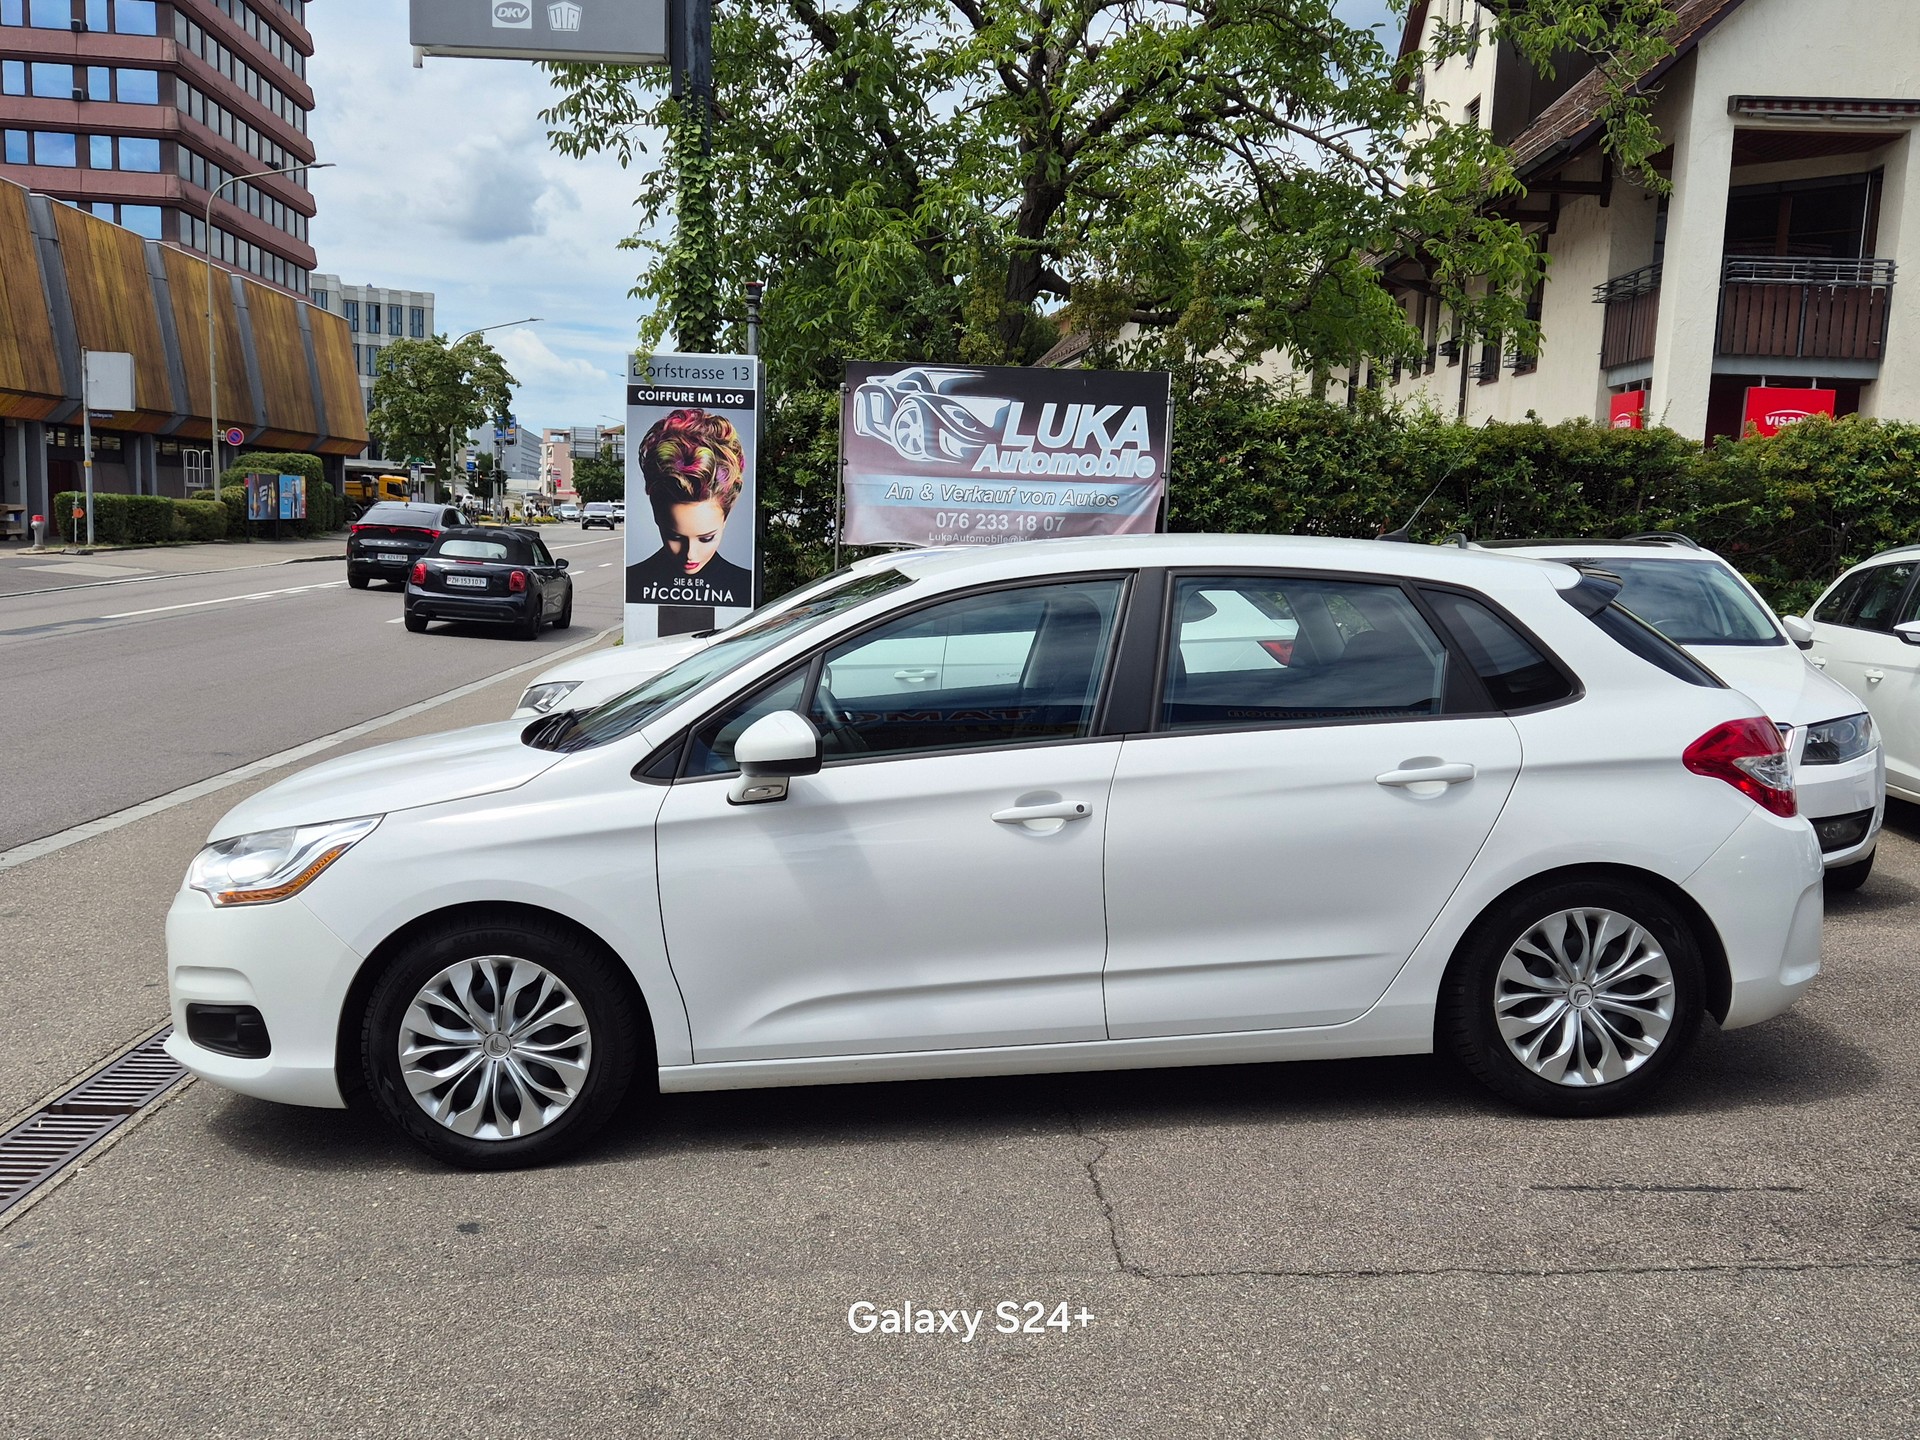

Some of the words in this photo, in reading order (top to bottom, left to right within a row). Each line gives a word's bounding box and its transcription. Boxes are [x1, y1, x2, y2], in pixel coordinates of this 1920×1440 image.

[497, 7, 527, 18] DKV
[549, 1, 581, 29] UTA
[732, 366, 749, 381] 13
[637, 390, 695, 403] COIFFURE
[697, 392, 713, 403] IM
[1001, 401, 1151, 451] LUKA
[1765, 415, 1805, 426] visa
[971, 443, 1156, 478] Automobile
[885, 482, 913, 500] An
[919, 483, 935, 501] &
[941, 484, 1017, 504] Verkauf
[1020, 490, 1056, 506] von
[1060, 489, 1119, 507] Autos
[936, 512, 970, 529] 076
[975, 513, 1009, 530] 233
[1016, 515, 1037, 532] 18
[1043, 516, 1066, 532] 07
[673, 577, 685, 586] SIE
[687, 578, 693, 586] &
[695, 578, 704, 587] ER
